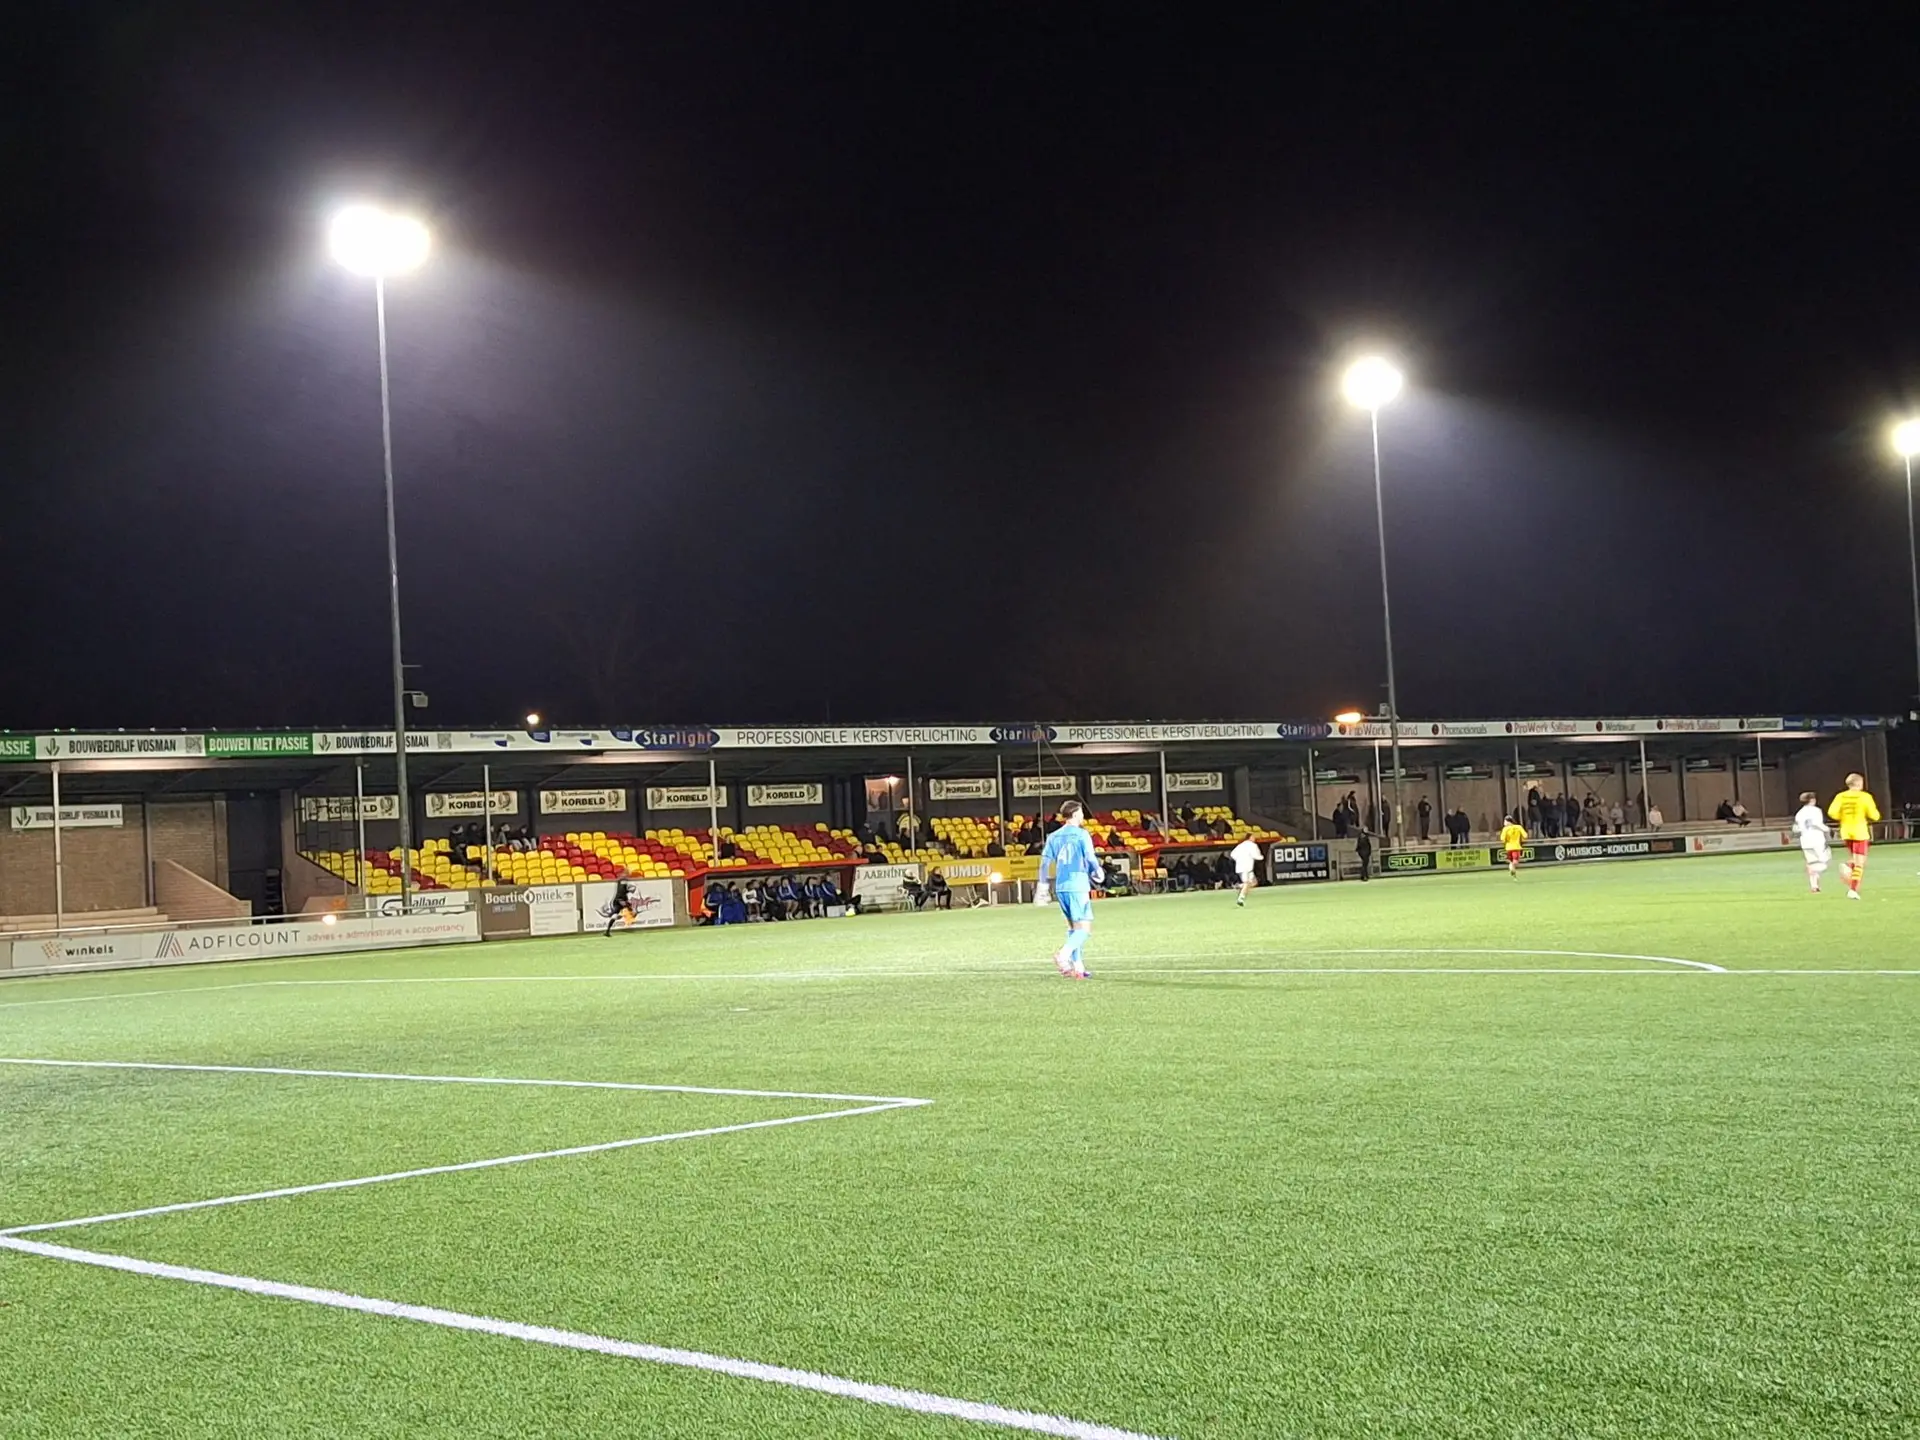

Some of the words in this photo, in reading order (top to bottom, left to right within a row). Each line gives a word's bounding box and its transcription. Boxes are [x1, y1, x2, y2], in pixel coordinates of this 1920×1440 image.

[643, 731, 712, 748] Starlight
[737, 730, 848, 745] PROFESSIONELE
[853, 728, 978, 743] KERSTVERLICHTING
[1069, 727, 1159, 740] PROFESSIONELE
[1162, 724, 1264, 739] KERSTVERLICHTING
[0, 740, 30, 755] ASSIE
[69, 739, 135, 753] BOUWBEDRIJF
[138, 738, 176, 752] VOSMAN
[209, 737, 251, 752] BOUWEN
[253, 736, 274, 751] MET
[275, 736, 309, 750] PASSIE
[336, 735, 394, 749] BOUWBEDRIJF
[406, 735, 429, 748] SMAN
[561, 797, 606, 807] KORBELD
[766, 791, 805, 800] KORBELD
[448, 800, 496, 810] KORBED
[943, 863, 993, 880] JUMBO
[189, 930, 300, 950] ADFICOUNT
[412, 923, 465, 935] accountancy
[65, 944, 114, 956] winkels
